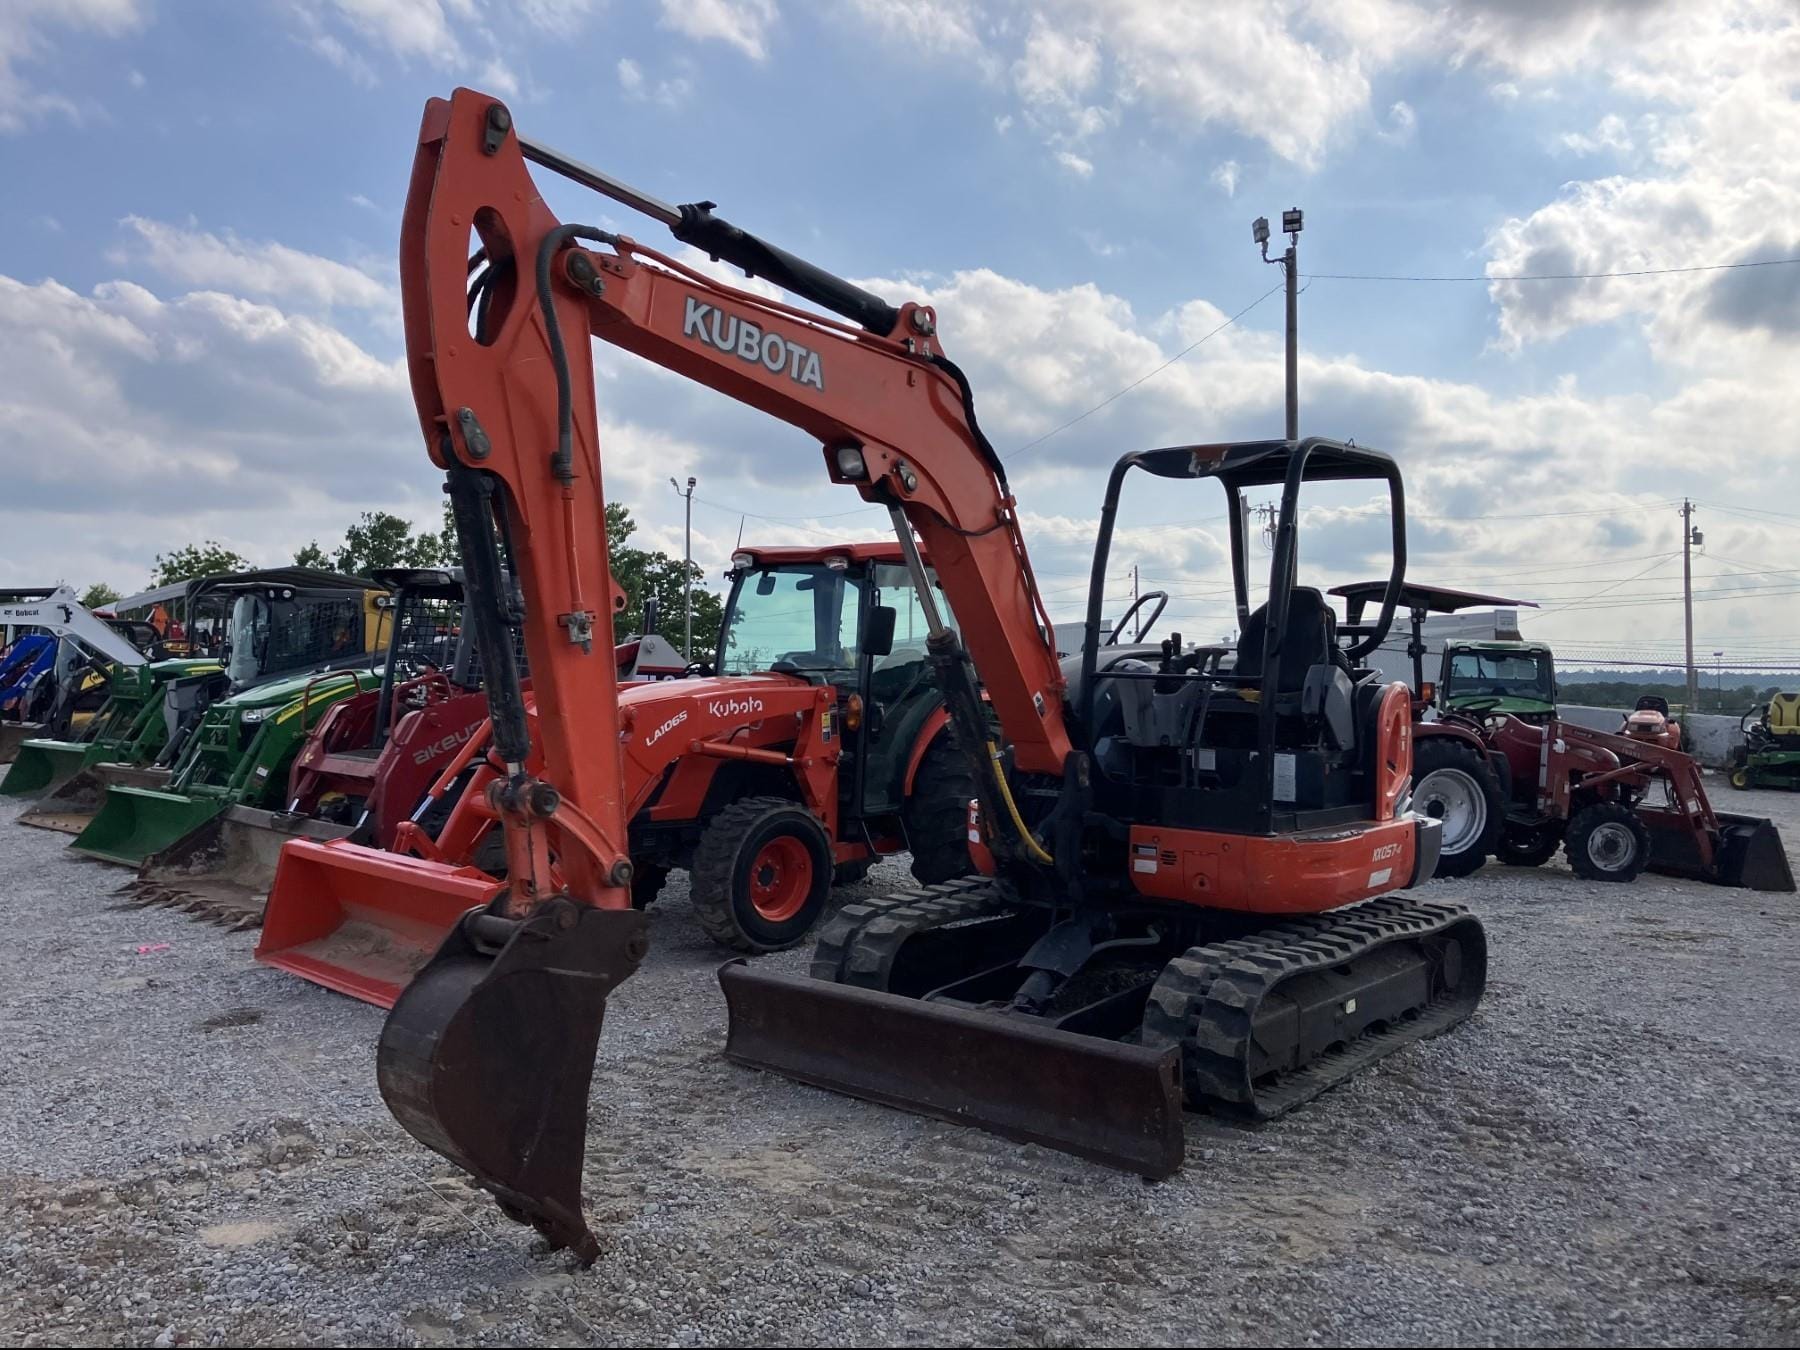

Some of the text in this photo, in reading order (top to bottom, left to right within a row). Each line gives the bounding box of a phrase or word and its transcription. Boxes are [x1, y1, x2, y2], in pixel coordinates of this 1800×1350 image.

[684, 296, 824, 390] KUBOTA
[15, 609, 40, 617] Bobcat
[709, 696, 763, 718] Kubota
